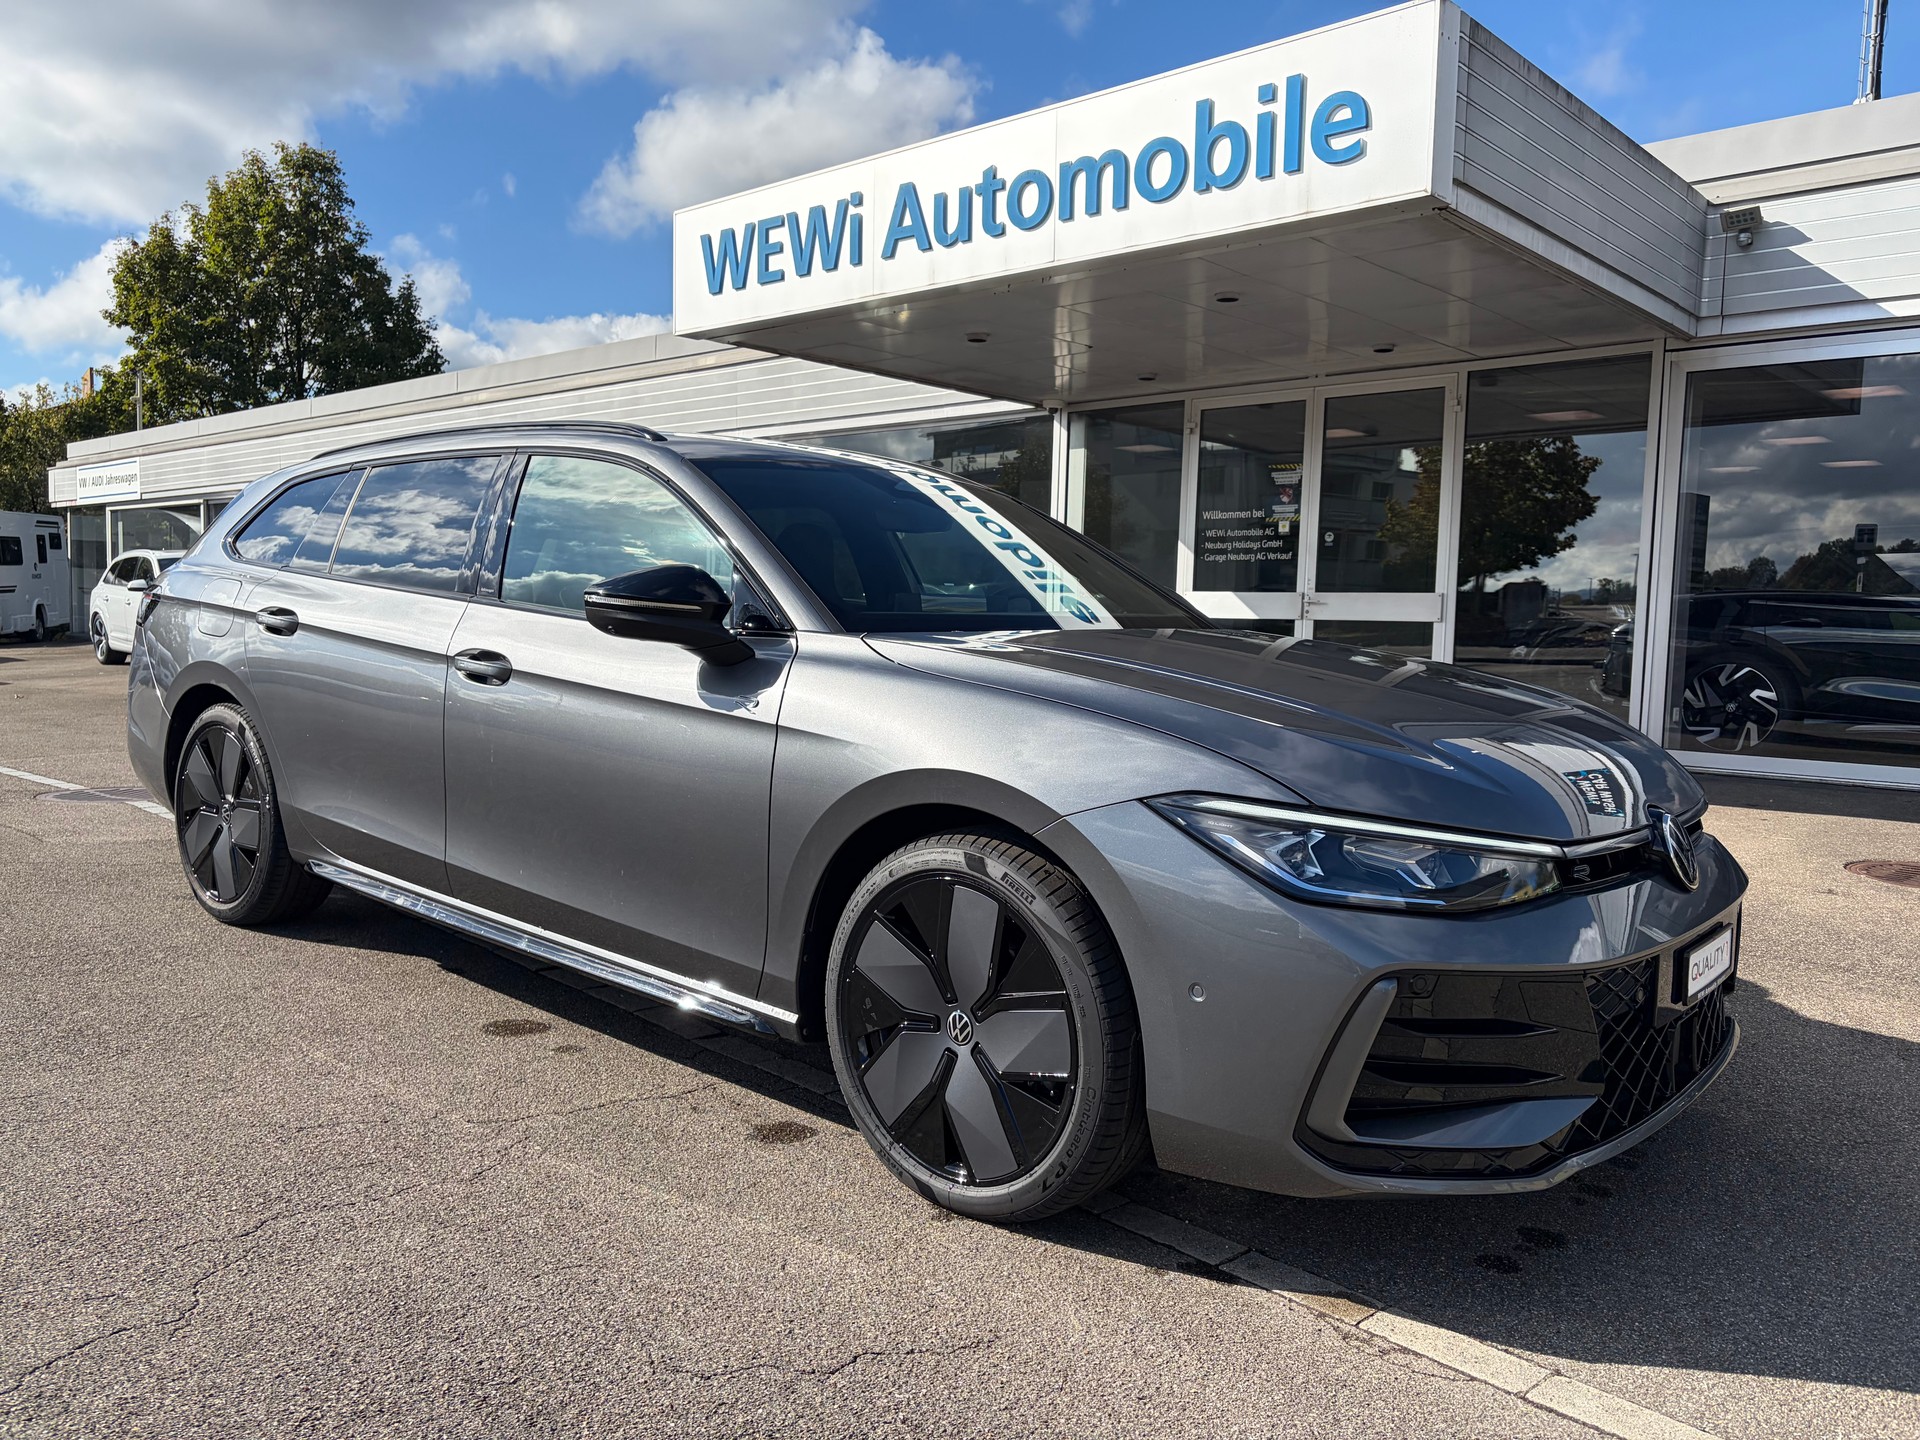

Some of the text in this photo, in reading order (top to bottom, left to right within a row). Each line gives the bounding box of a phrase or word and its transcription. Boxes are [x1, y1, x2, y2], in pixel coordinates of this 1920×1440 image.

[700, 74, 1371, 295] WEWi Automobile
[79, 478, 87, 488] VW
[91, 475, 104, 487] AUDI
[105, 473, 138, 486] Jahreswagen
[1203, 510, 1251, 519] Willkommen
[1252, 509, 1265, 517] bei
[1206, 529, 1226, 537] WEWi
[1227, 528, 1263, 537] Automobile
[1205, 542, 1231, 550] Neuburg
[1233, 540, 1260, 550] Holidays
[1262, 540, 1283, 548] GmbH
[1204, 553, 1226, 563] Garage
[1228, 553, 1255, 562] Neuburg
[1256, 552, 1266, 560] AG
[1267, 551, 1293, 560] Verkauf
[1000, 871, 1036, 906] PIRELLI
[1064, 1085, 1097, 1162] Cinturato
